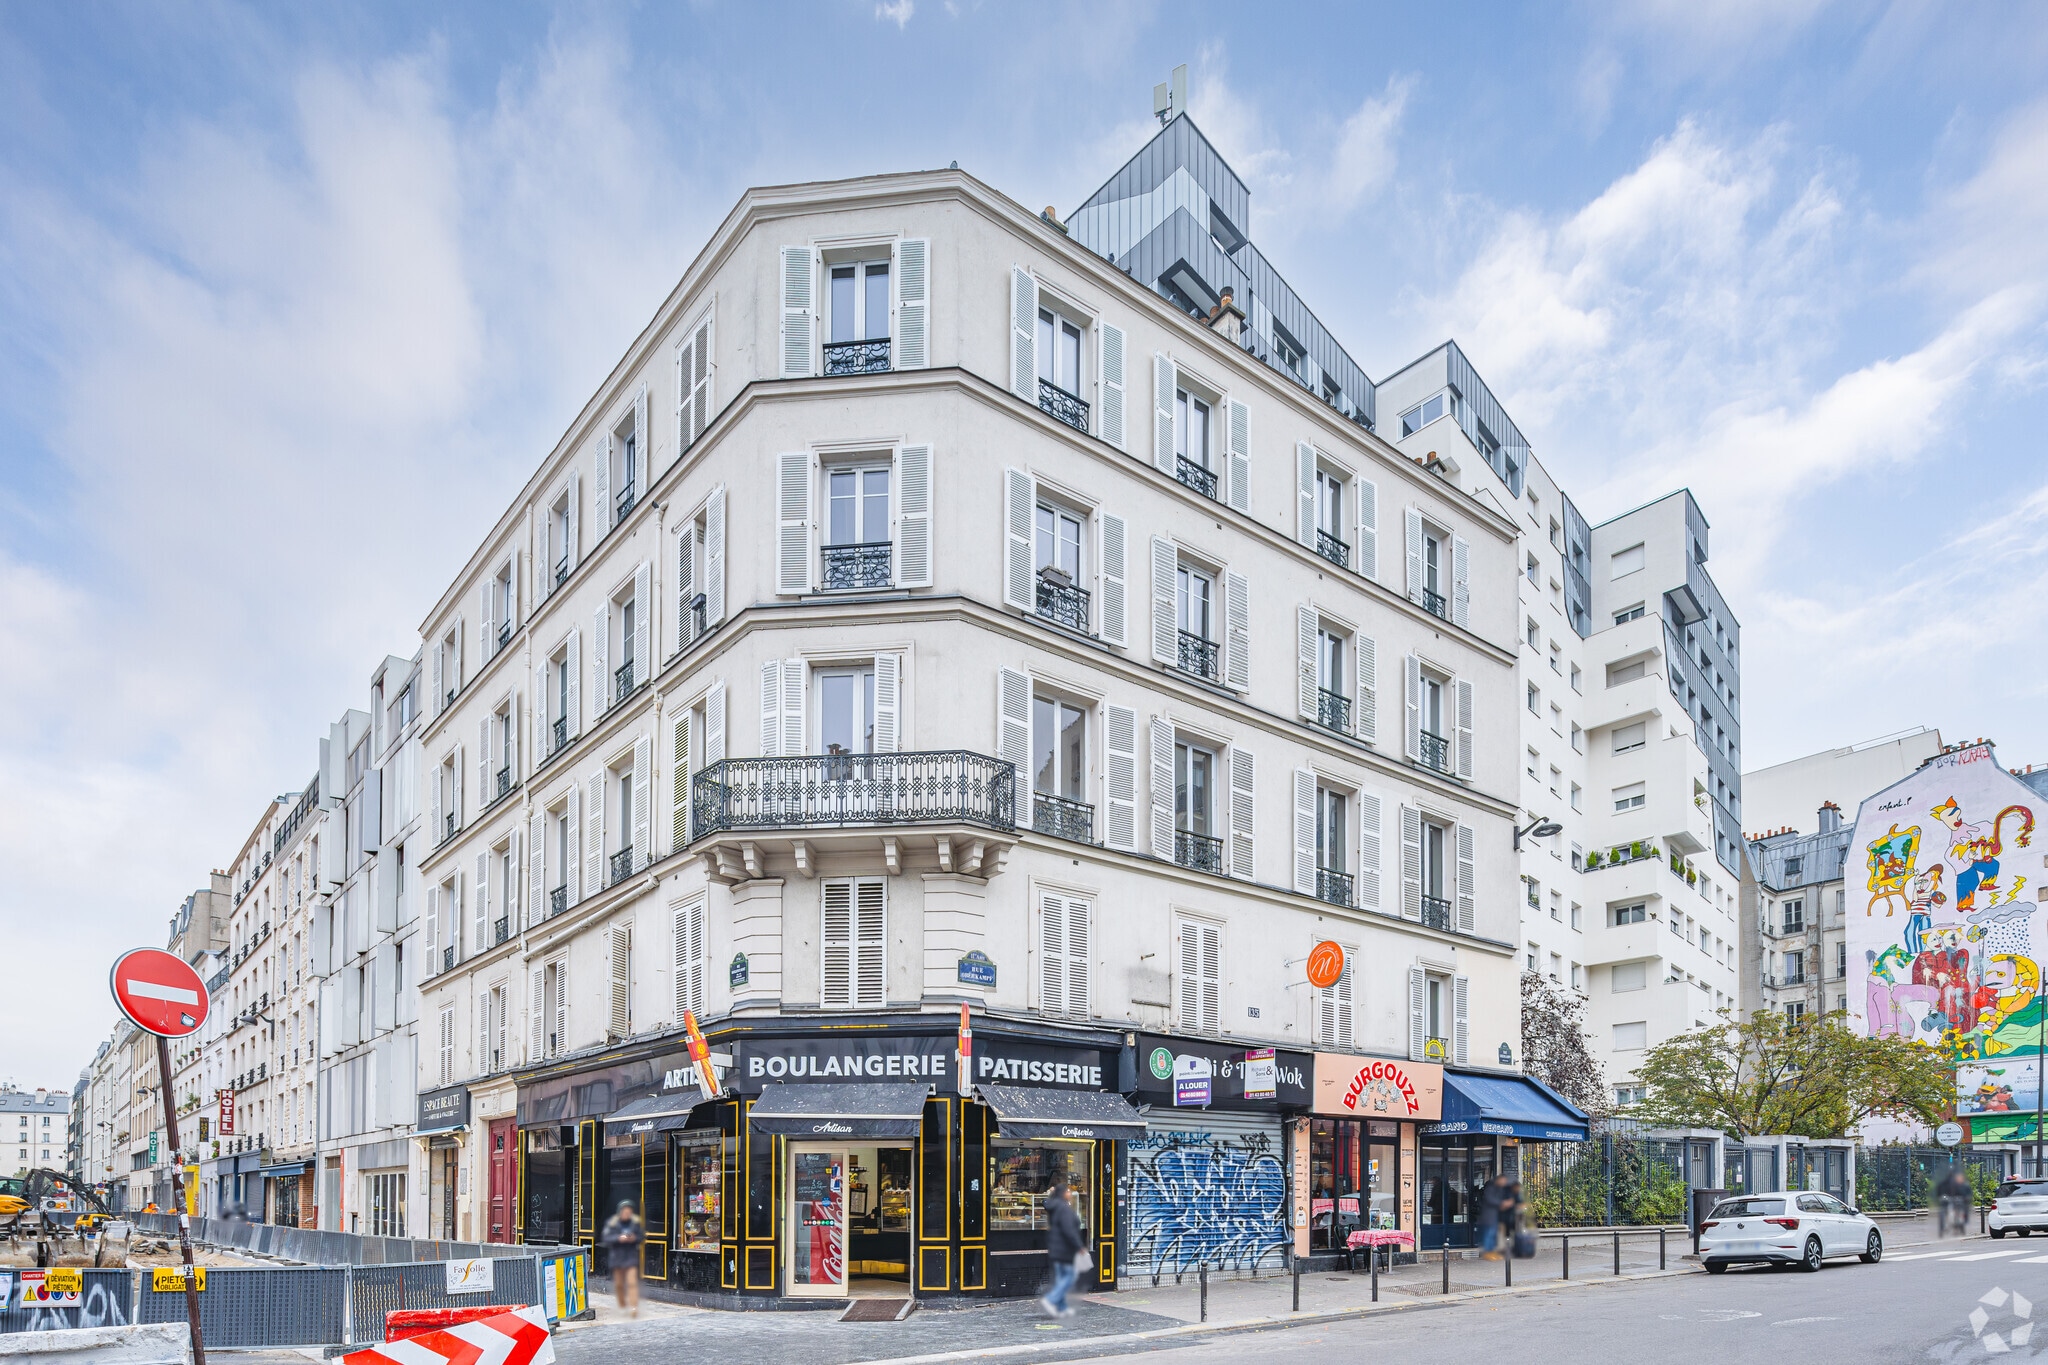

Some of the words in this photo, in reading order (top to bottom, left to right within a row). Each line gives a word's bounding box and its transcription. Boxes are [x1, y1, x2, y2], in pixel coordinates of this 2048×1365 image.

[971, 966, 984, 974] RUE
[749, 1055, 946, 1077] BOULANGERIE
[979, 1056, 1102, 1086] PATISSERIE
[663, 1066, 726, 1090] ARTIN
[1221, 1059, 1233, 1078] &
[1275, 1065, 1306, 1089] Wok
[1185, 1082, 1208, 1090] LOUER
[1342, 1061, 1420, 1116] BURGOUZZ
[222, 1090, 233, 1131] HOTEL
[812, 1121, 853, 1133] Artisan
[1061, 1125, 1094, 1138] Confiserie
[1482, 1122, 1514, 1134] MENGANO
[51, 1274, 76, 1283] DÉVIATION
[161, 1276, 198, 1284] PIETOS
[53, 1283, 74, 1291] PIÉTONS
